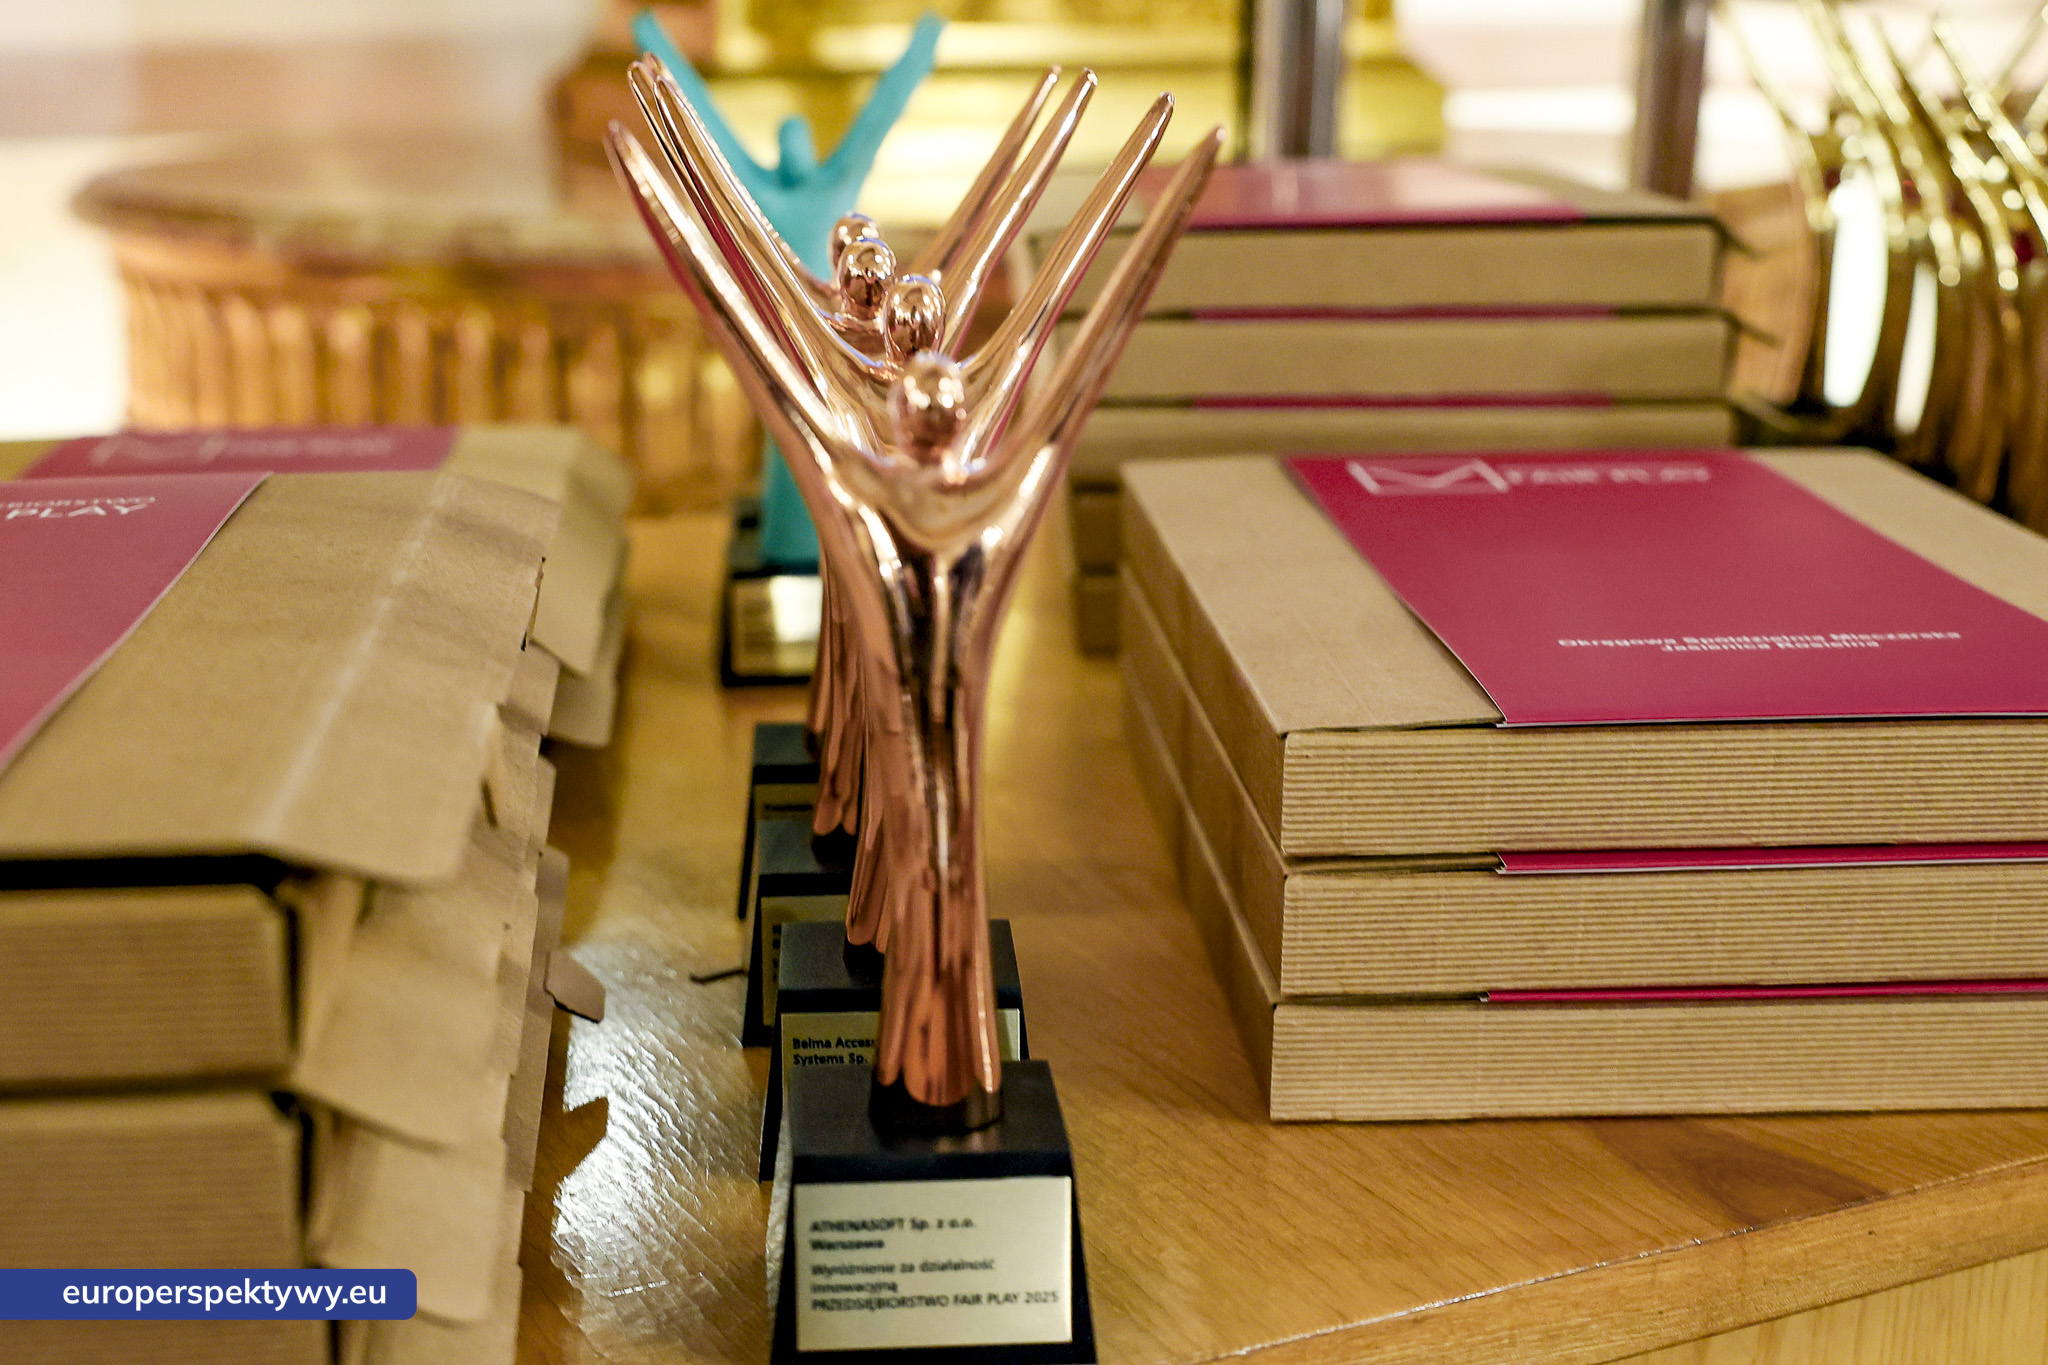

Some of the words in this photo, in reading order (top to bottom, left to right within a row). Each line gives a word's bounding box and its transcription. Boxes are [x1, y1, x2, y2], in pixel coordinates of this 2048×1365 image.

[5, 503, 148, 520] PLAY
[835, 1036, 875, 1049] Acces
[793, 1053, 845, 1066] Systems
[848, 1052, 868, 1065] Sp.
[810, 1217, 904, 1233] ATHENASOFT
[911, 1217, 930, 1231] Sp.
[810, 1238, 885, 1250] Warszawa
[900, 1262, 916, 1273] za
[812, 1294, 949, 1313] PRZEDSIĘBIORSTWO
[953, 1293, 983, 1306] FAIR
[987, 1292, 1018, 1305] PLAY
[1024, 1290, 1059, 1304] 2025
